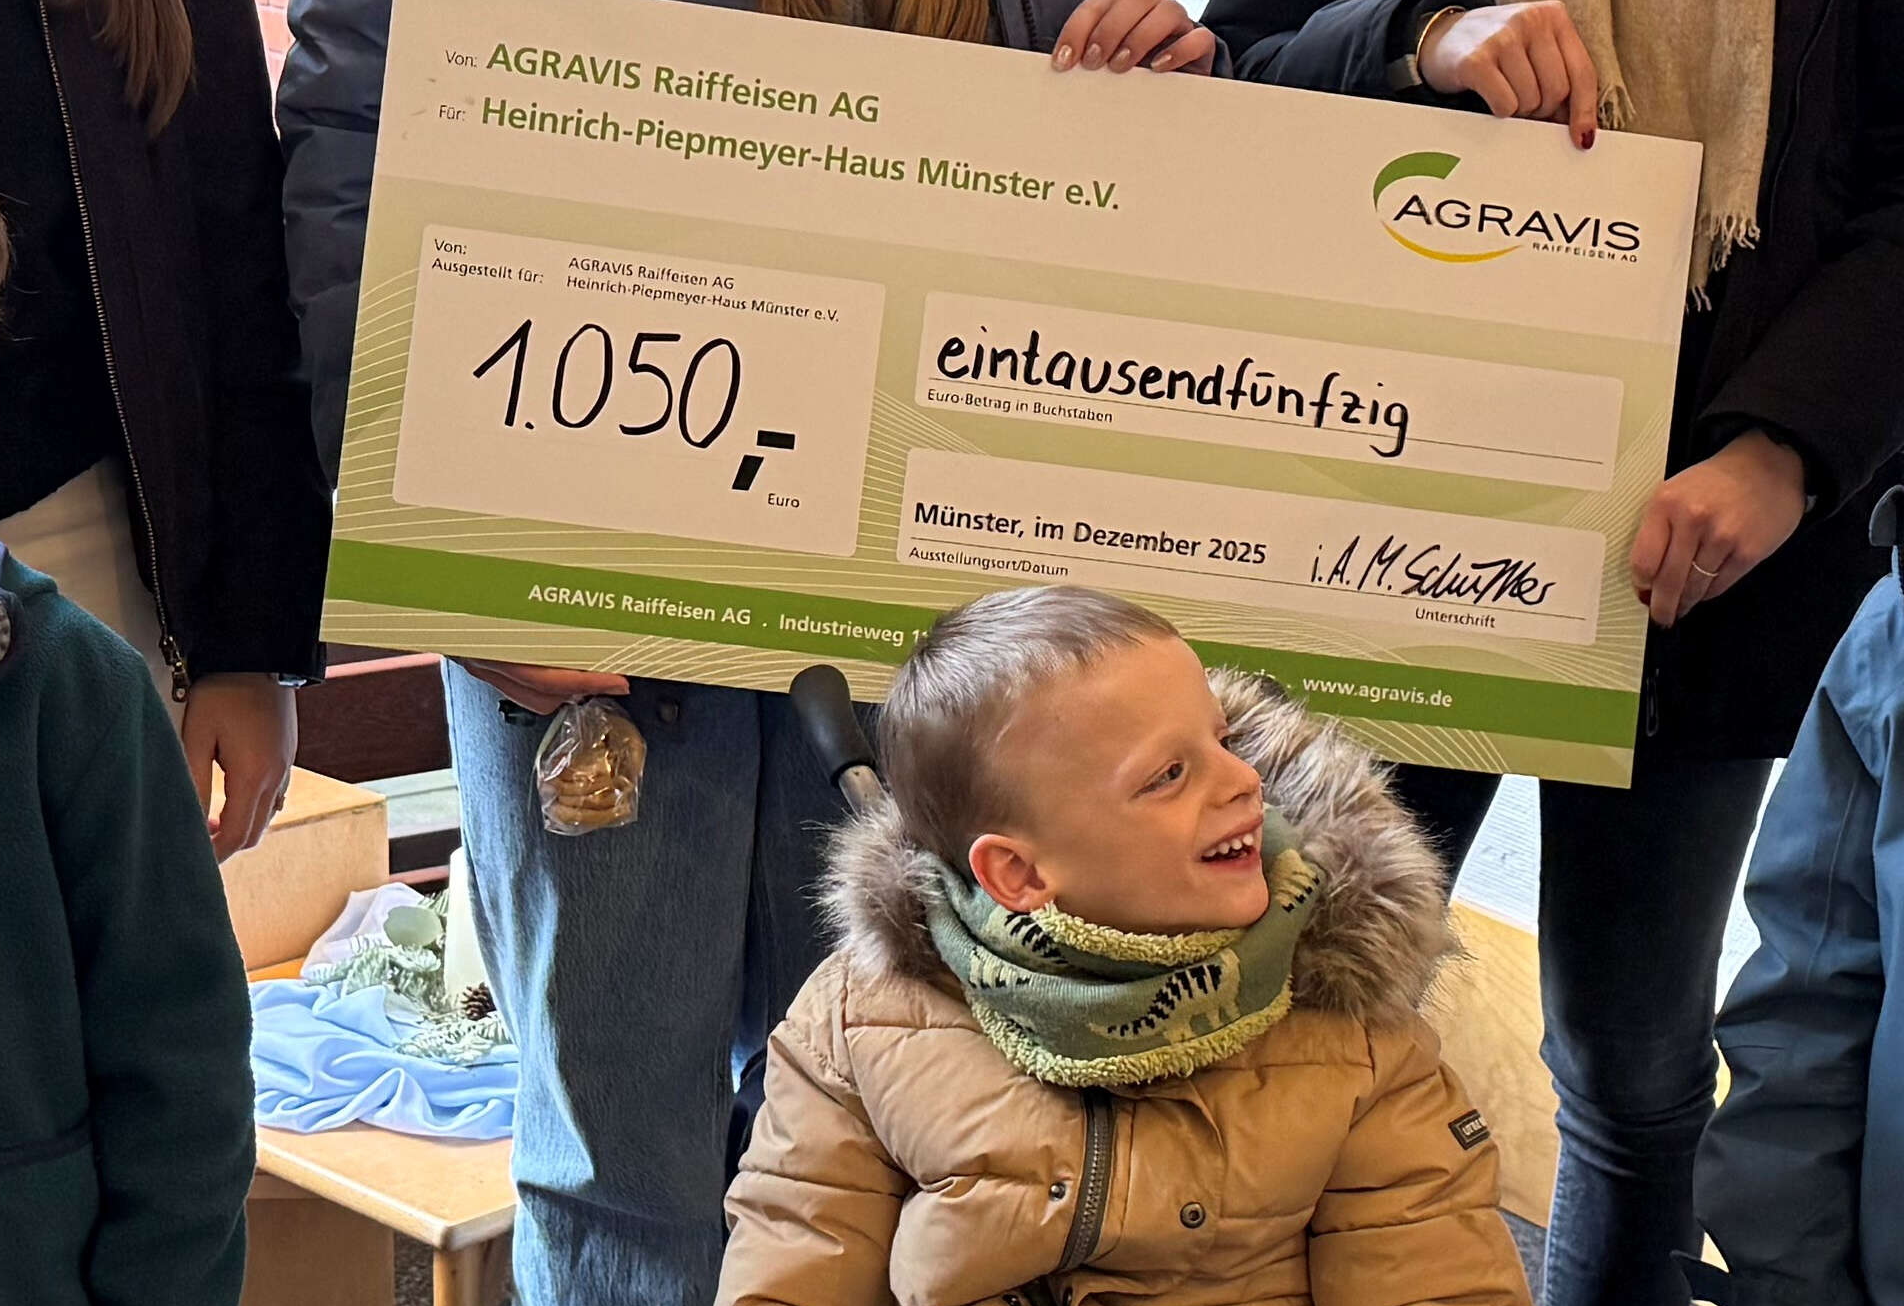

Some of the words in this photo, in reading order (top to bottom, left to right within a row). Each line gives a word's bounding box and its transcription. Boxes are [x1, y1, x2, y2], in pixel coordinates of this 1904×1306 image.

[445, 50, 478, 68] Von:
[486, 43, 642, 90] AGRAVIS
[653, 66, 817, 114] Raiffeisen
[829, 91, 880, 123] AG
[439, 104, 466, 121] Für:
[482, 97, 906, 181] Heinrich-Piepmeyer-Haus
[917, 157, 1055, 201] Münster
[1065, 180, 1120, 210] e.V.
[1393, 194, 1641, 251] AGRAVIS
[434, 238, 467, 255] Von:
[1532, 242, 1616, 260] RAIFFEISEN
[1621, 253, 1638, 263] AG
[431, 257, 513, 281] Ausgestellt
[517, 267, 544, 285] für:
[568, 257, 634, 277] AGRAVIS
[638, 265, 708, 287] Raiffeisen
[711, 276, 735, 290] AG
[566, 276, 747, 311] Heinrich-Piepmeyer-Haus
[751, 299, 810, 319] Münster
[814, 309, 840, 323] e.V.
[927, 388, 1012, 414] Euro-Betrag
[1015, 400, 1028, 413] in
[1033, 402, 1113, 423] Buchstaben
[936, 325, 1409, 458] eintausendfünfzig
[767, 493, 800, 509] Euro
[914, 501, 1025, 539] Münster,
[1034, 516, 1064, 541] im
[1073, 521, 1201, 557] Dezember
[1207, 538, 1267, 565] 2025
[909, 546, 1069, 577] Ausstellungsort/Datum
[528, 583, 615, 610] AGRAVIS
[621, 594, 716, 622] Raiffeisen
[721, 609, 752, 625] AG
[779, 613, 904, 645] Industrieweg
[1415, 607, 1496, 629] Unterschrift
[1303, 676, 1453, 708] www.agravis.de
